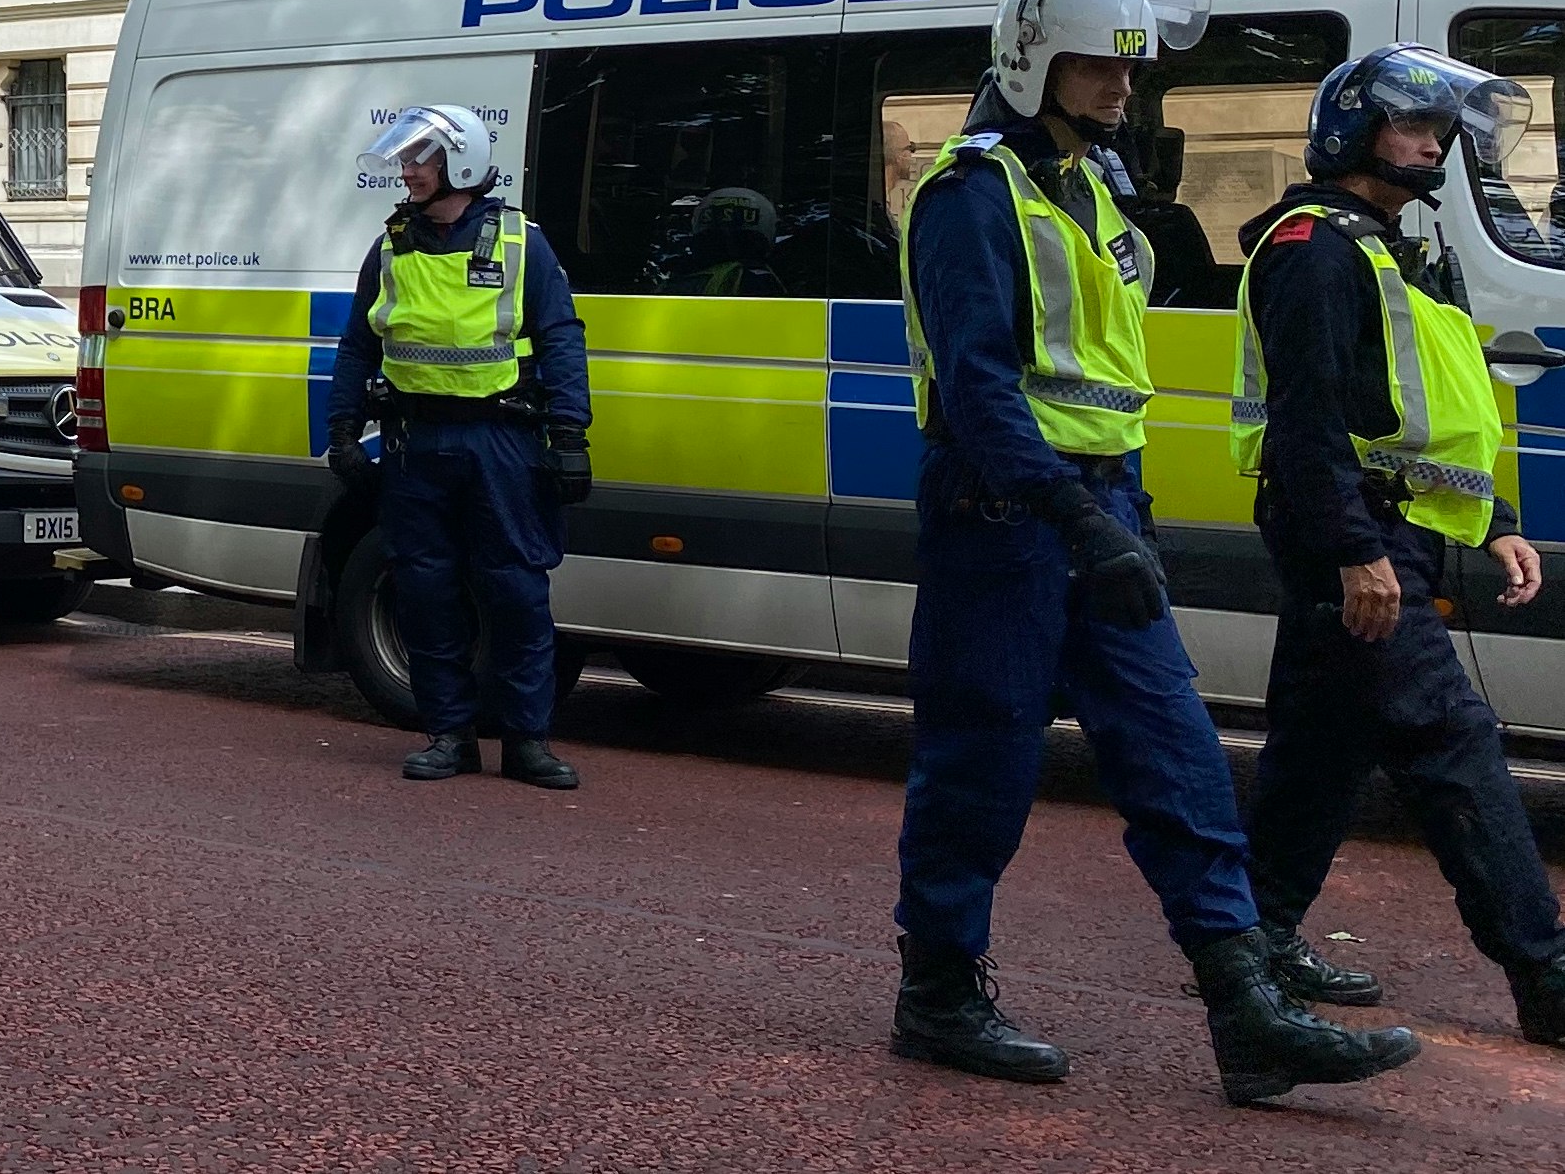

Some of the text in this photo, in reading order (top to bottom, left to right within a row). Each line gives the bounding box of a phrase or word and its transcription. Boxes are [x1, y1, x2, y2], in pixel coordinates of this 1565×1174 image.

[1116, 30, 1145, 54] MP
[1408, 67, 1438, 85] MP
[356, 172, 408, 188] Searc
[129, 252, 260, 268] www.met.police.uk
[129, 297, 176, 320] BRA
[35, 517, 73, 539] BX15
